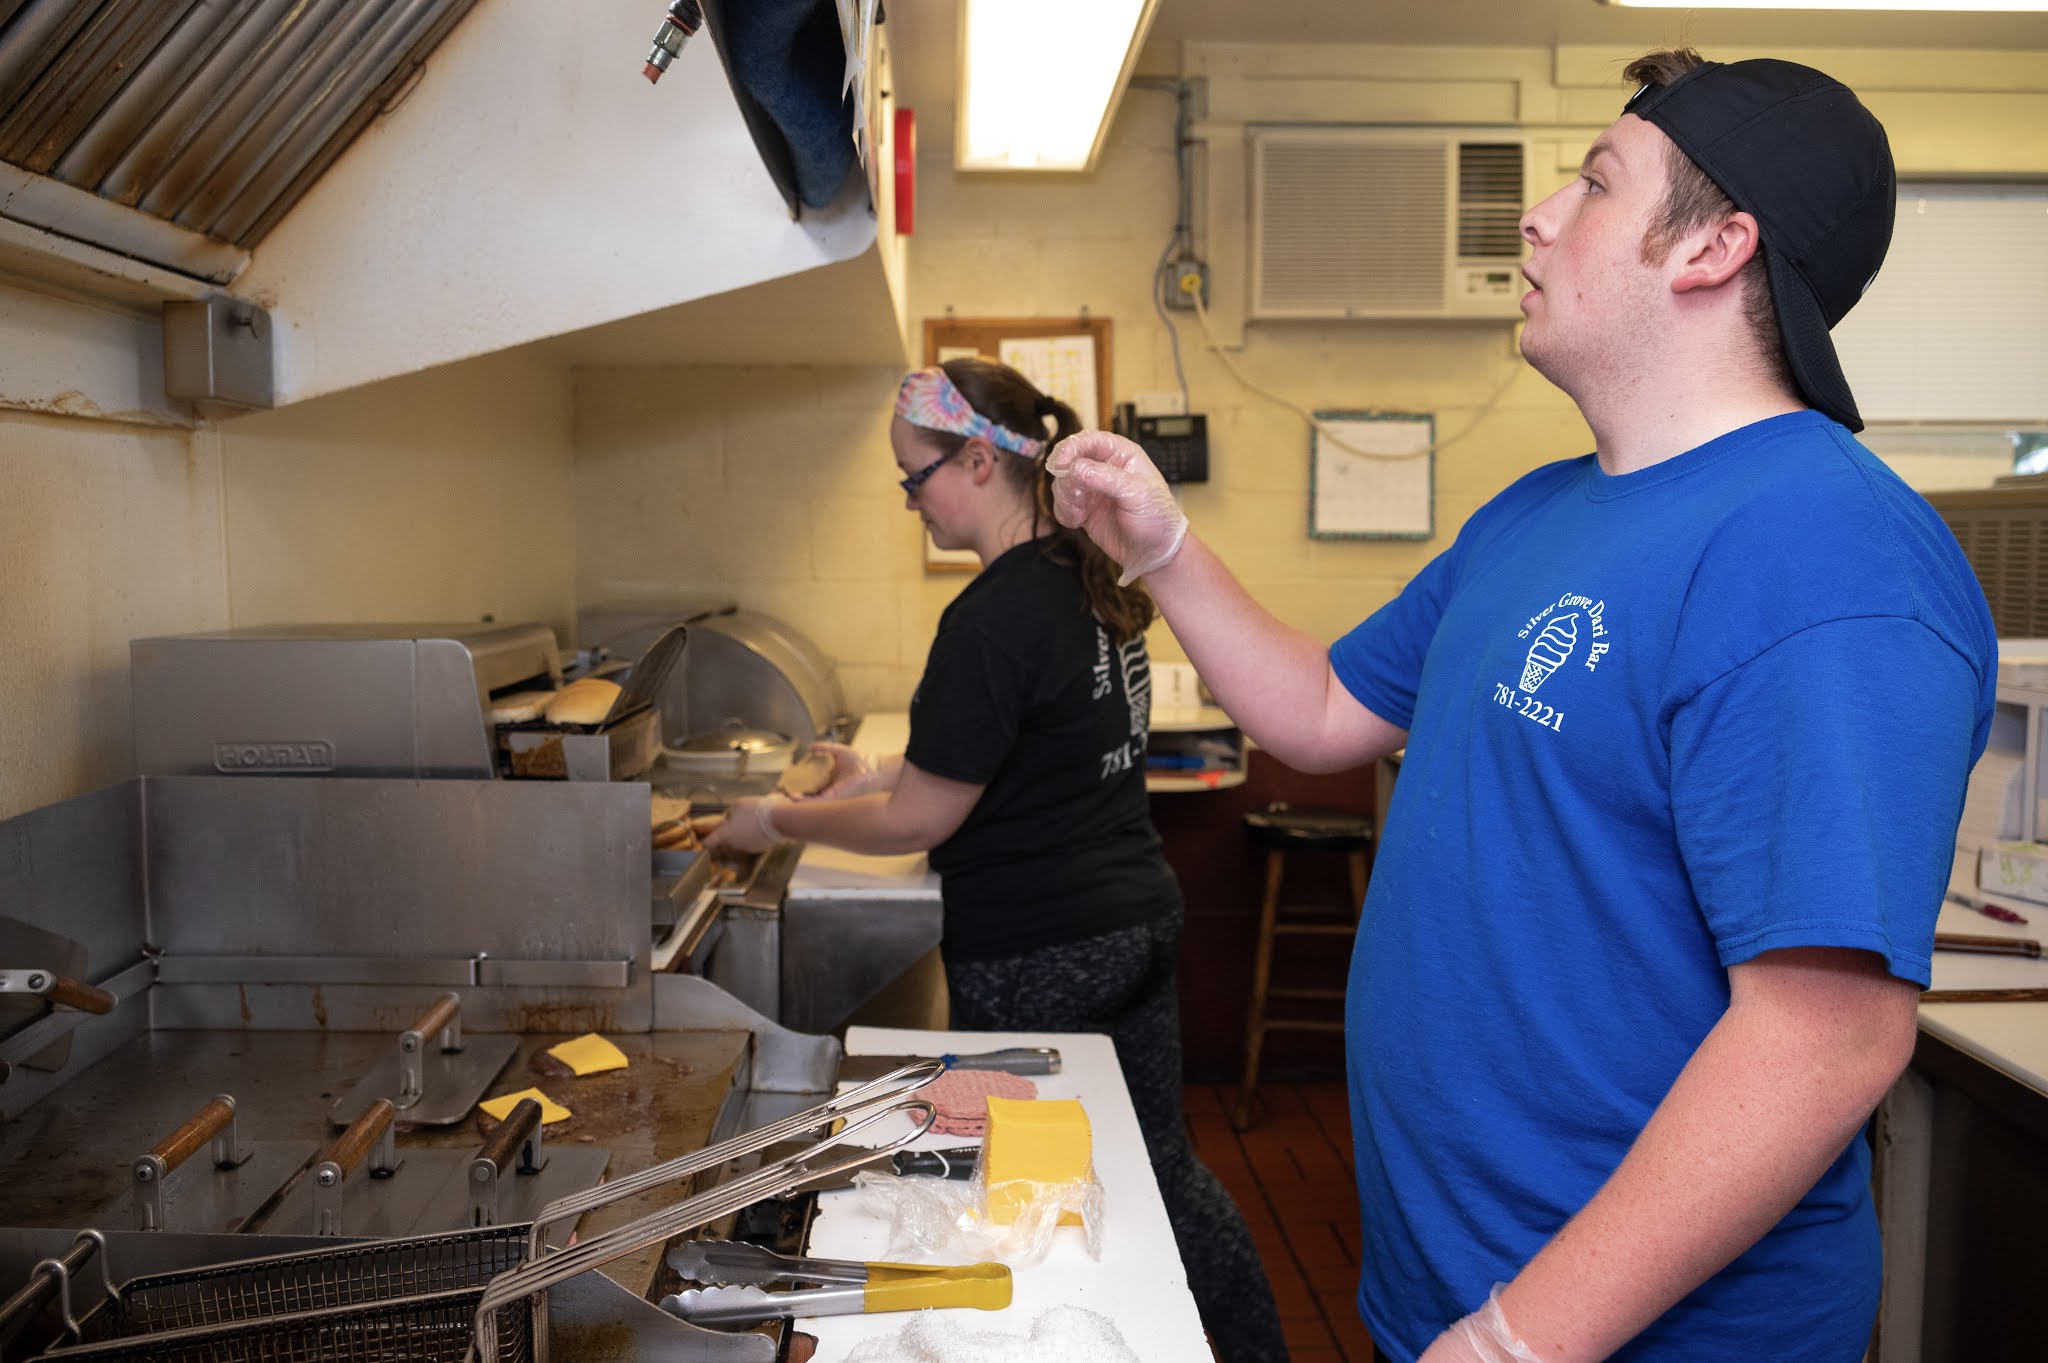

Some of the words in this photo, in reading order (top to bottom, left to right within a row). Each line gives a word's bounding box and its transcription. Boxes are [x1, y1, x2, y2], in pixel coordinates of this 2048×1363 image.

[1558, 592, 1593, 610] Grove
[1587, 600, 1609, 639] Dari
[1518, 603, 1556, 639] Silver
[1092, 625, 1113, 700] Silver
[1585, 642, 1610, 672] Bar
[1493, 682, 1565, 732] 781-2221
